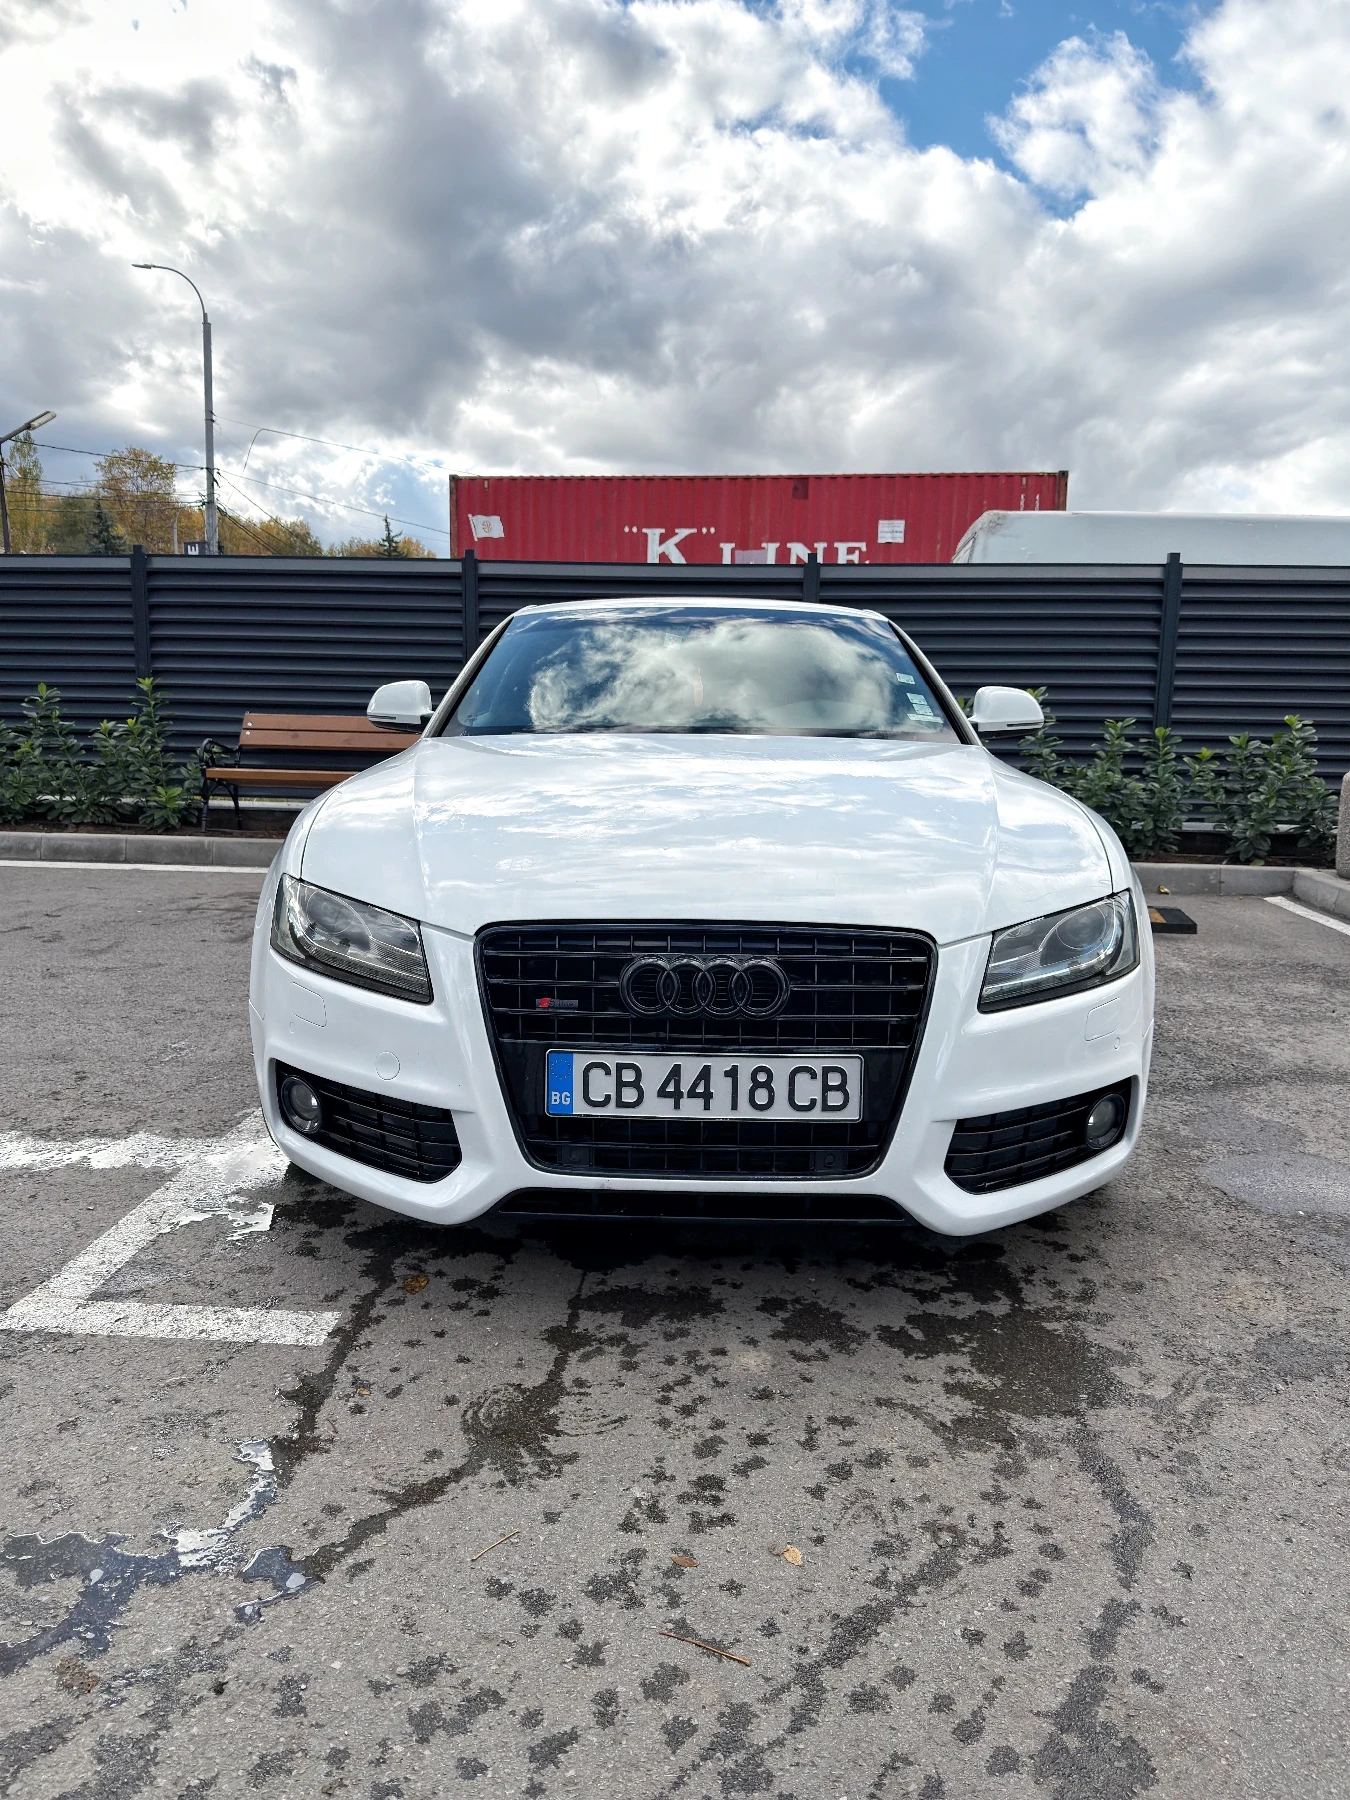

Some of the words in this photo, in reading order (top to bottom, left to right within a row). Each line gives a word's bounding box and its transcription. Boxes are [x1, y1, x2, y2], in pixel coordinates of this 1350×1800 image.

[551, 1091, 571, 1105] BG
[582, 1061, 645, 1108] CB
[656, 1062, 775, 1111] 4418
[788, 1065, 850, 1112] CB
